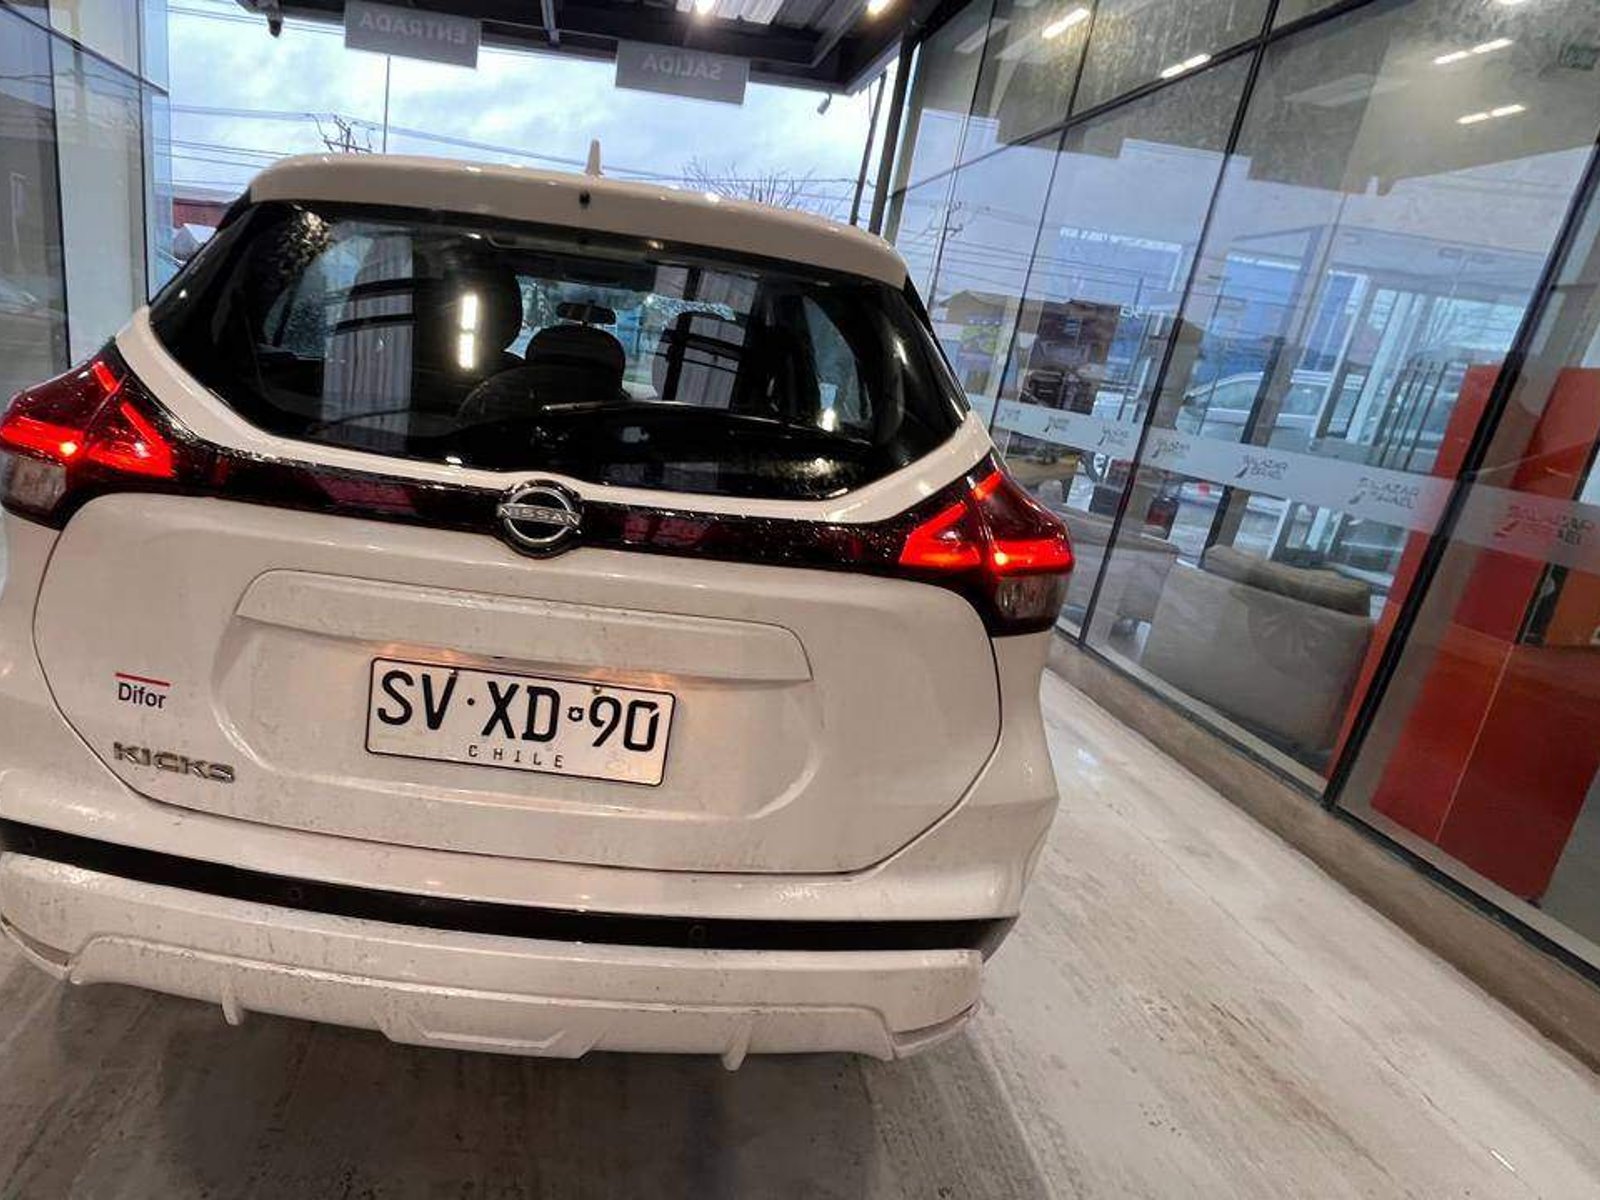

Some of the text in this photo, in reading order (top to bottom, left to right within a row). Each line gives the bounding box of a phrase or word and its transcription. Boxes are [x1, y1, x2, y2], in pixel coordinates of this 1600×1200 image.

[500, 505, 580, 527] NISSAN
[118, 682, 167, 709] Difor
[113, 741, 235, 783] KICKS
[468, 744, 564, 768] CHILE
